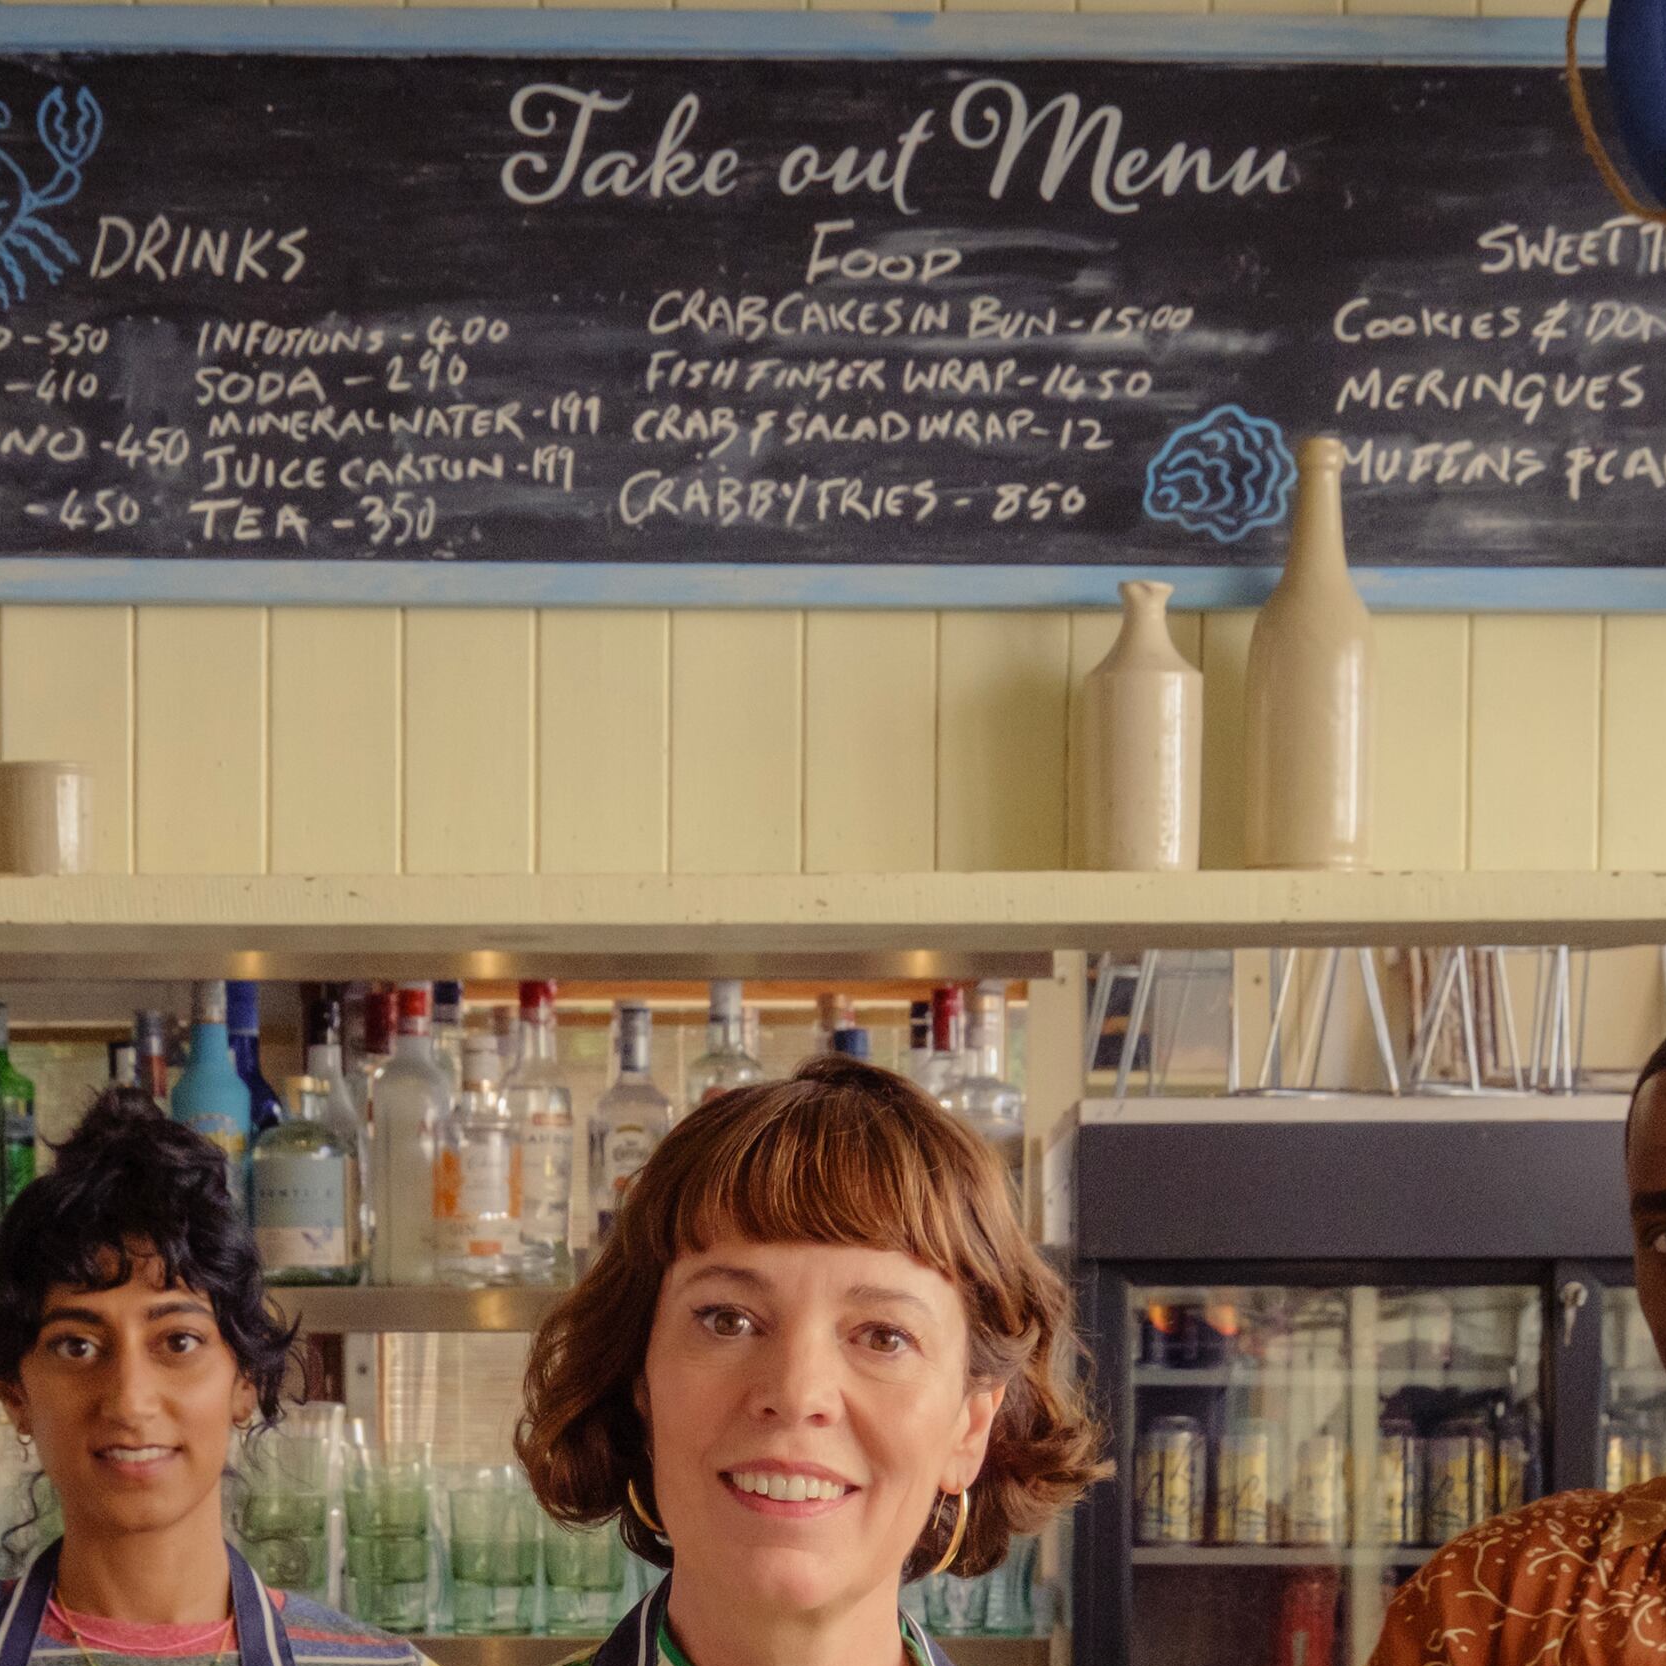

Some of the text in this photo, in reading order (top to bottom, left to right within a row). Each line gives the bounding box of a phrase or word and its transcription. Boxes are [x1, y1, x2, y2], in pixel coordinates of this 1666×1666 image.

[500, 78, 1293, 214] Take out Menu
[90, 216, 309, 282] DRINKS
[806, 218, 963, 284] FOOD
[1478, 214, 1644, 275] SWEET
[968, 295, 1057, 341] BUN
[1333, 297, 1522, 346] COOKIES
[195, 366, 327, 407] SODA
[1336, 364, 1645, 424] MERINGUES
[632, 403, 740, 459] CRAB
[783, 410, 911, 446] SALAD
[202, 444, 328, 492] JUICE
[189, 498, 309, 545] TEA
